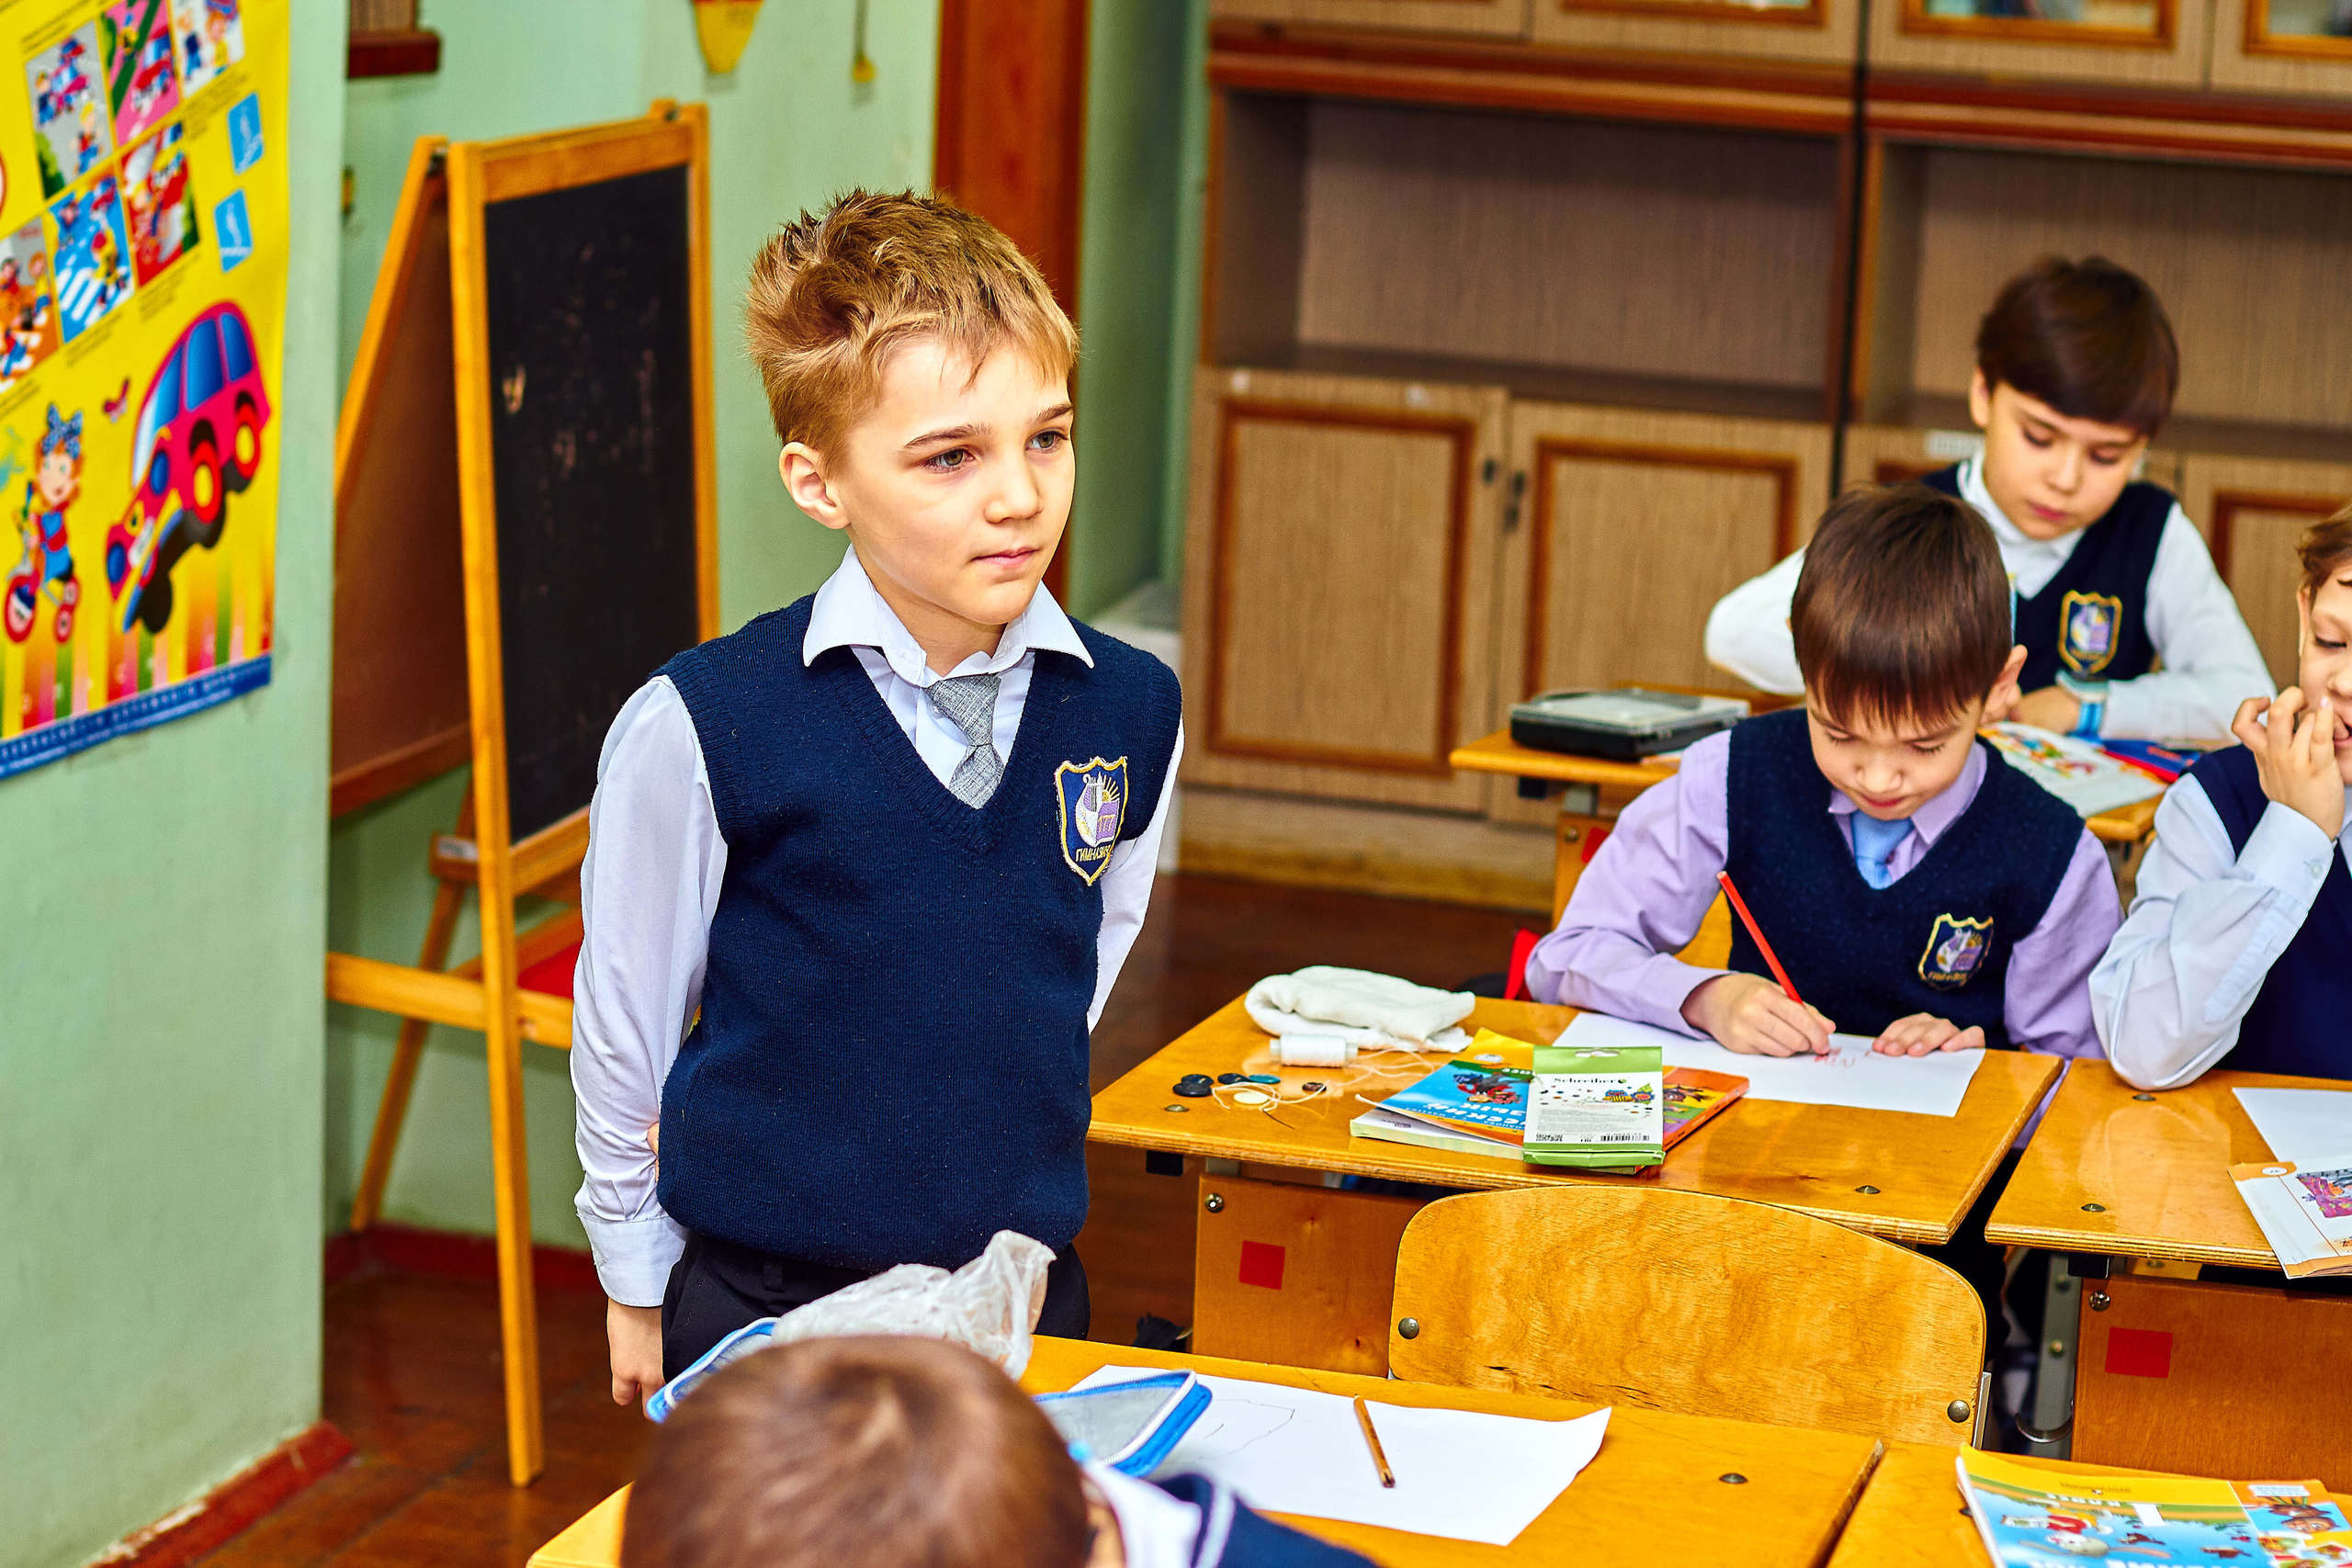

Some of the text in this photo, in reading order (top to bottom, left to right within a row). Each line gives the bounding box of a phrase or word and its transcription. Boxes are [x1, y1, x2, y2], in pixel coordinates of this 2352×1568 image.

[1098, 815, 1114, 833] 177
[1424, 1103, 1527, 1125] ССКИЙ
[1459, 1102, 1526, 1116] ЗЫК
